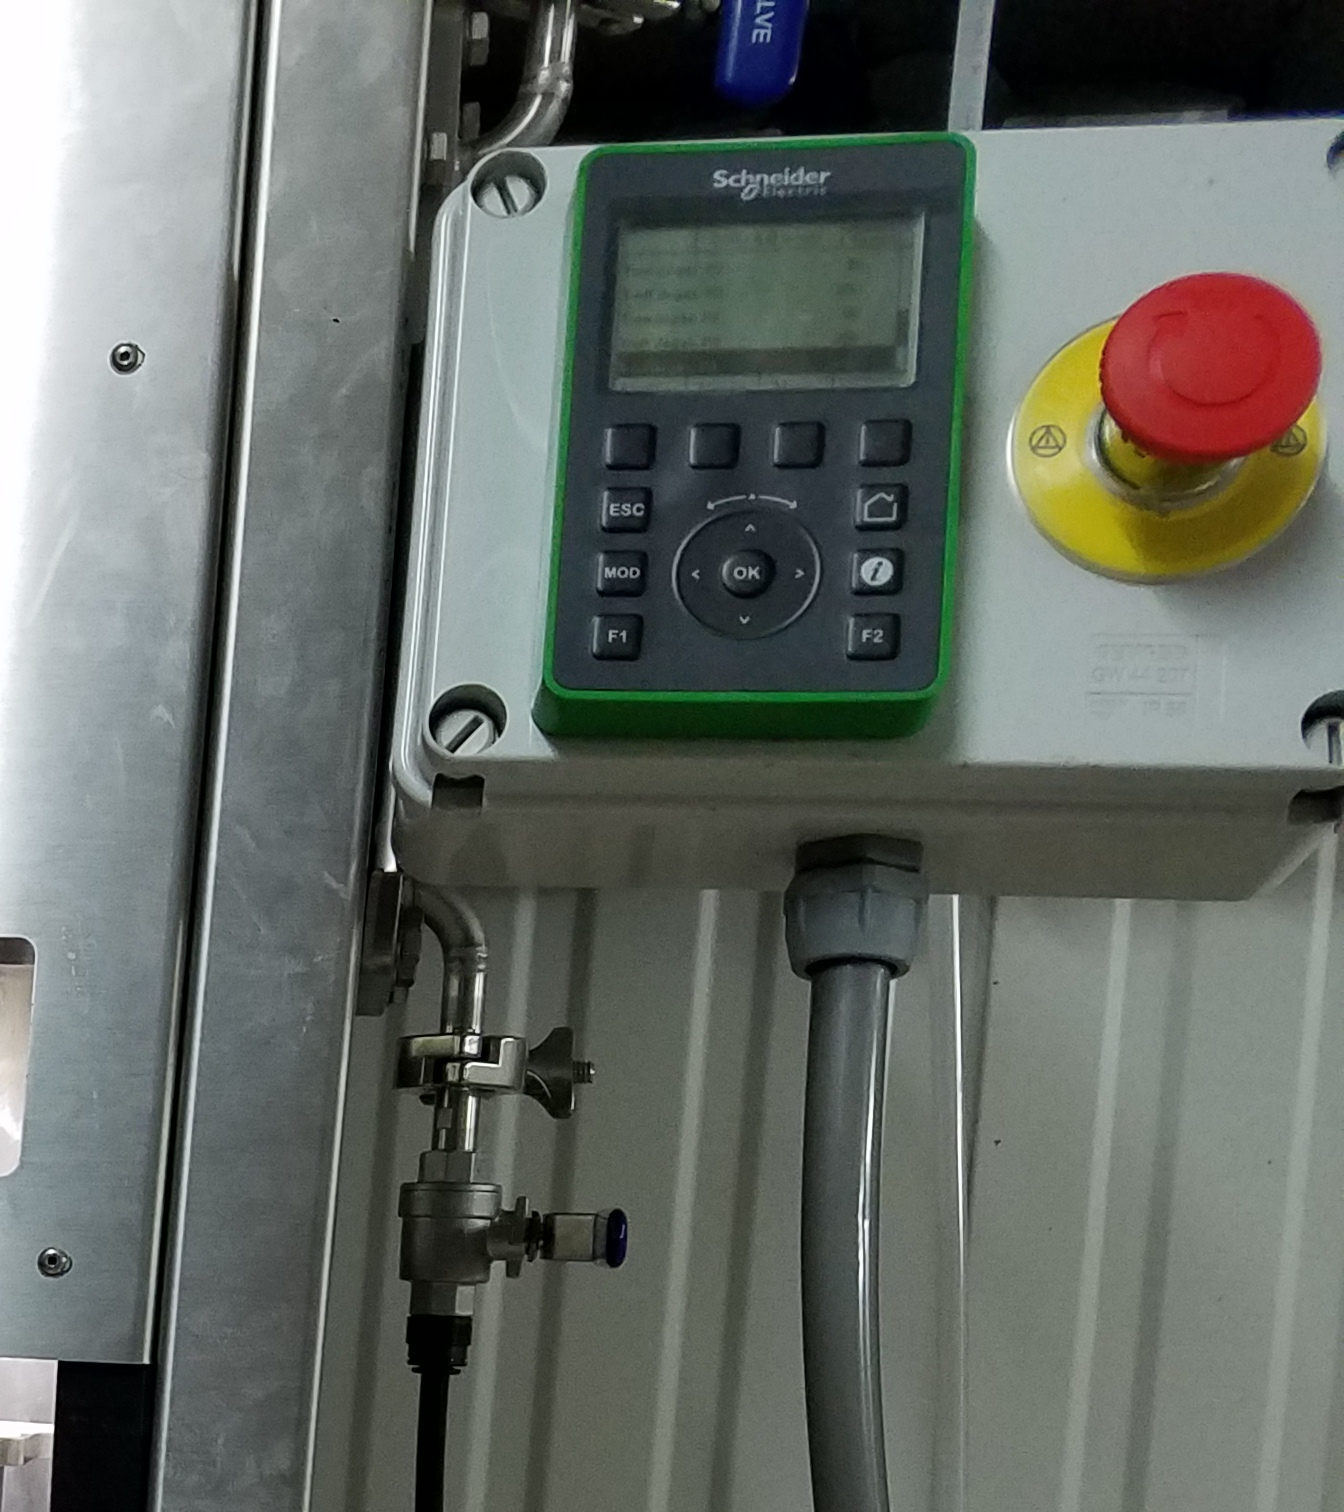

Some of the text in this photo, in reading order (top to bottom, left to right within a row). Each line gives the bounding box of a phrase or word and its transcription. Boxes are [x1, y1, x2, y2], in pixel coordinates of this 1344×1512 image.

[712, 166, 831, 189] Schneider
[608, 502, 645, 517] ESC
[604, 566, 641, 580] MOD
[733, 566, 761, 580] OK
[607, 629, 627, 644] F1
[861, 628, 884, 643] F2
